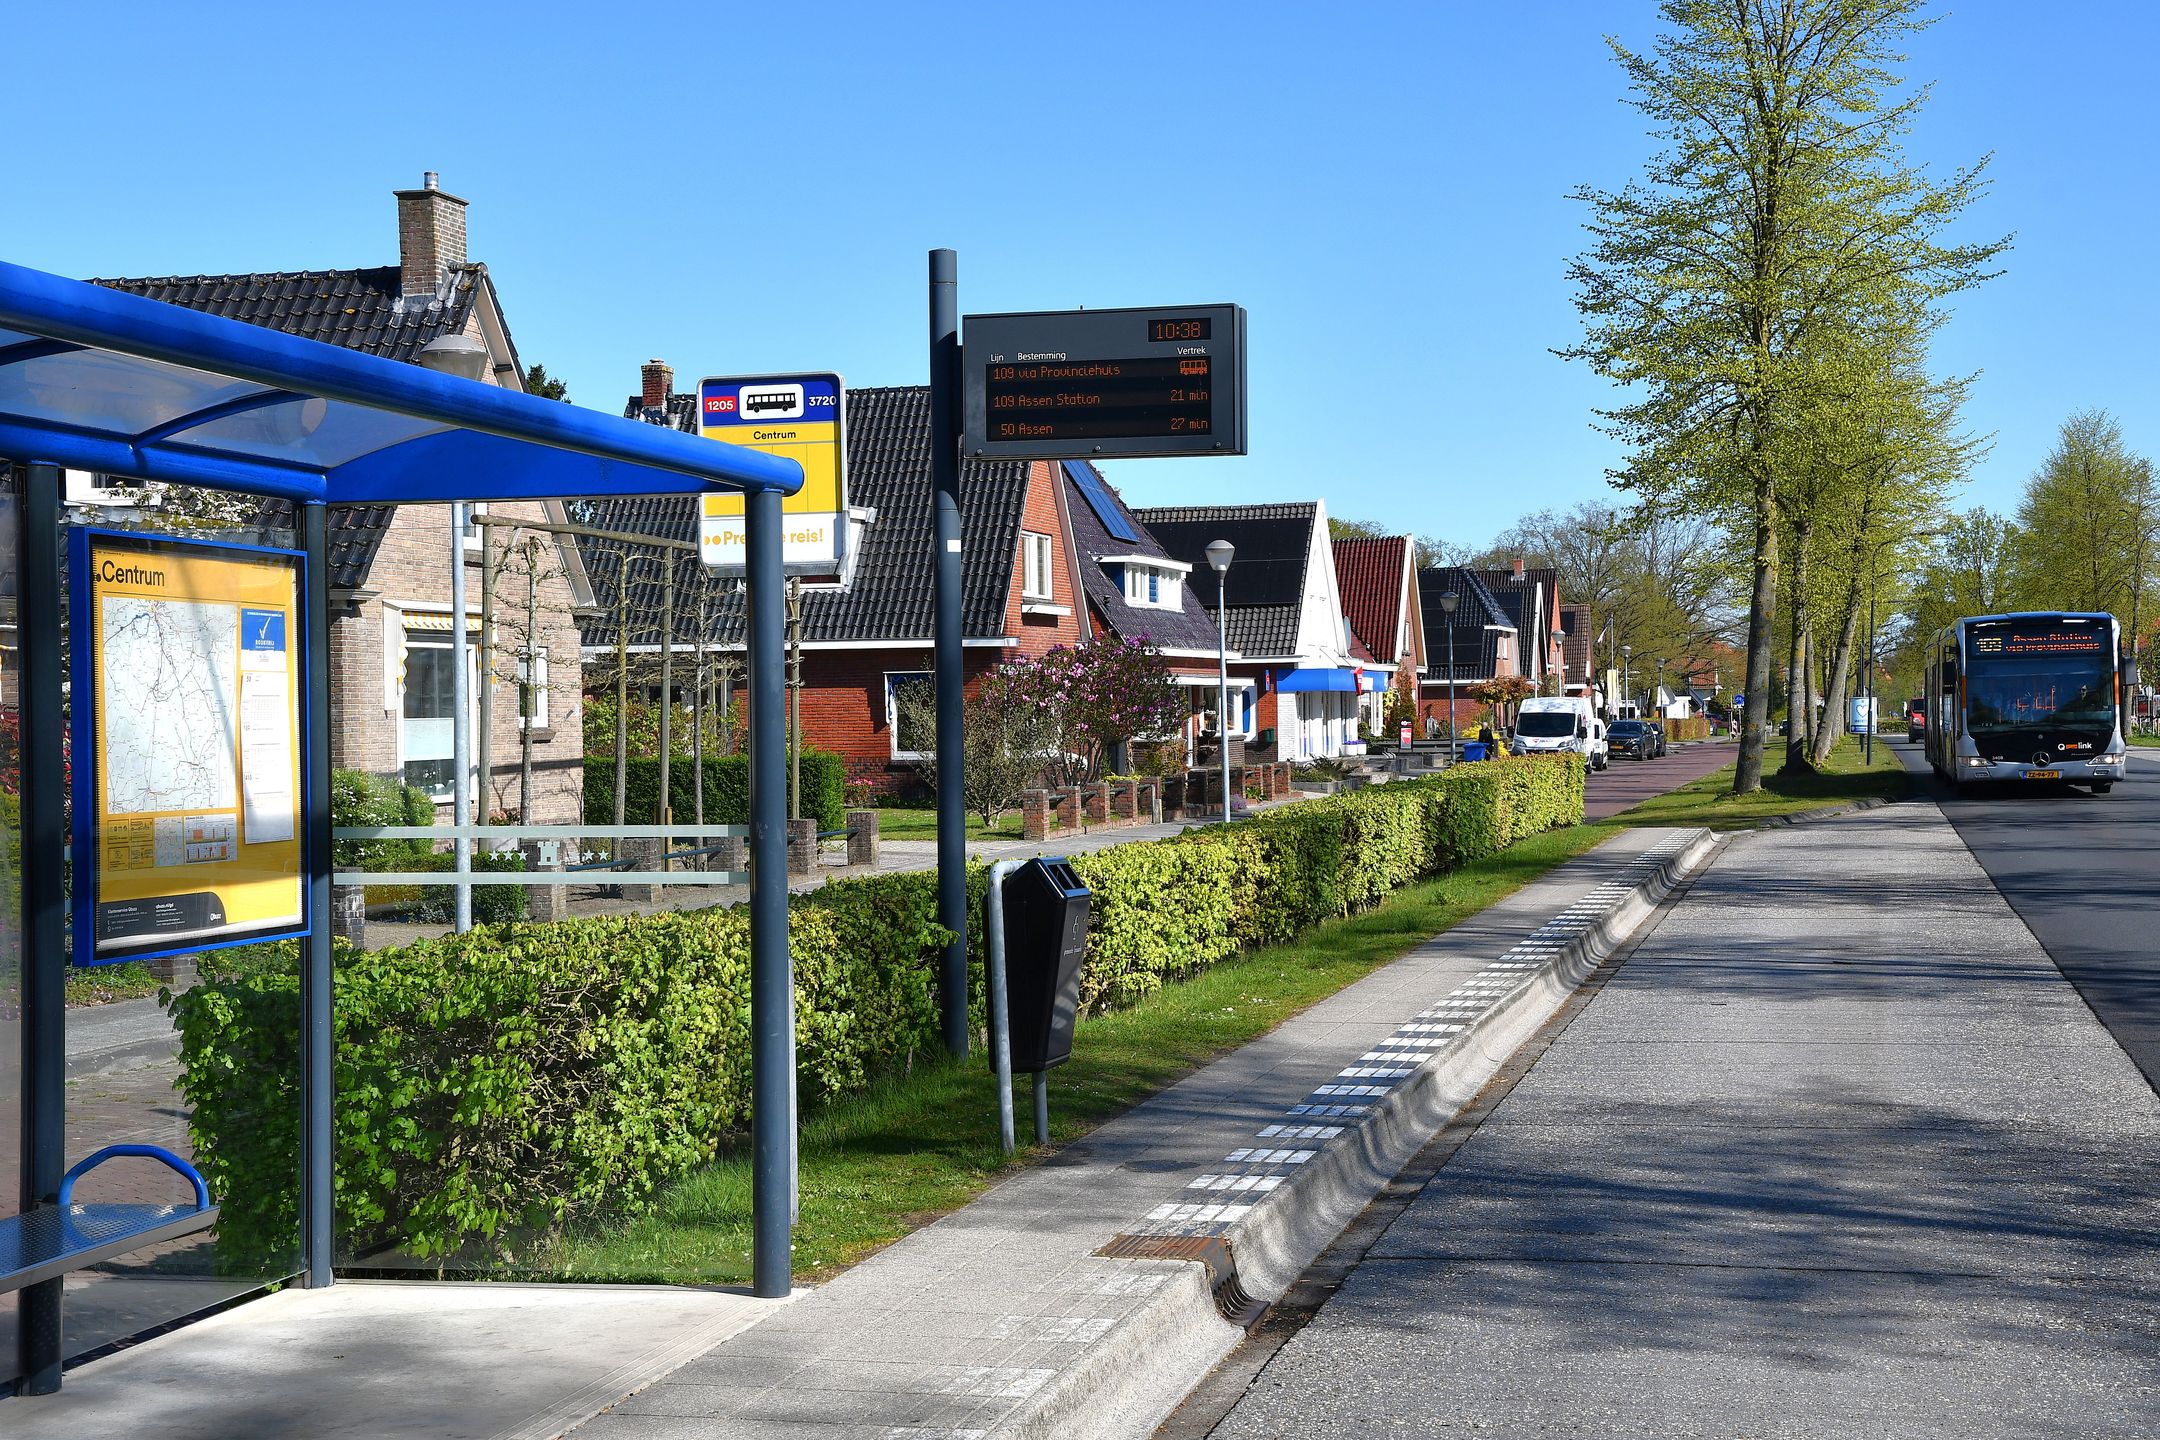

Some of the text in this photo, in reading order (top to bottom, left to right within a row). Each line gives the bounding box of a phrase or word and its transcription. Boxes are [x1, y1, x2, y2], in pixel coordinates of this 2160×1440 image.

[1156, 322, 1201, 339] 10:38
[990, 346, 1206, 362] Lijn Bestemming Vertrek
[994, 365, 1121, 380] 109 via Provinciehuis
[707, 396, 837, 410] 1205 3720
[994, 390, 1208, 408] 109 Assen Station 21 min
[753, 430, 797, 440] Centrum
[1001, 418, 1208, 436] 50 Assen 27 min
[790, 528, 823, 543] reis!
[102, 560, 165, 587] Centrum
